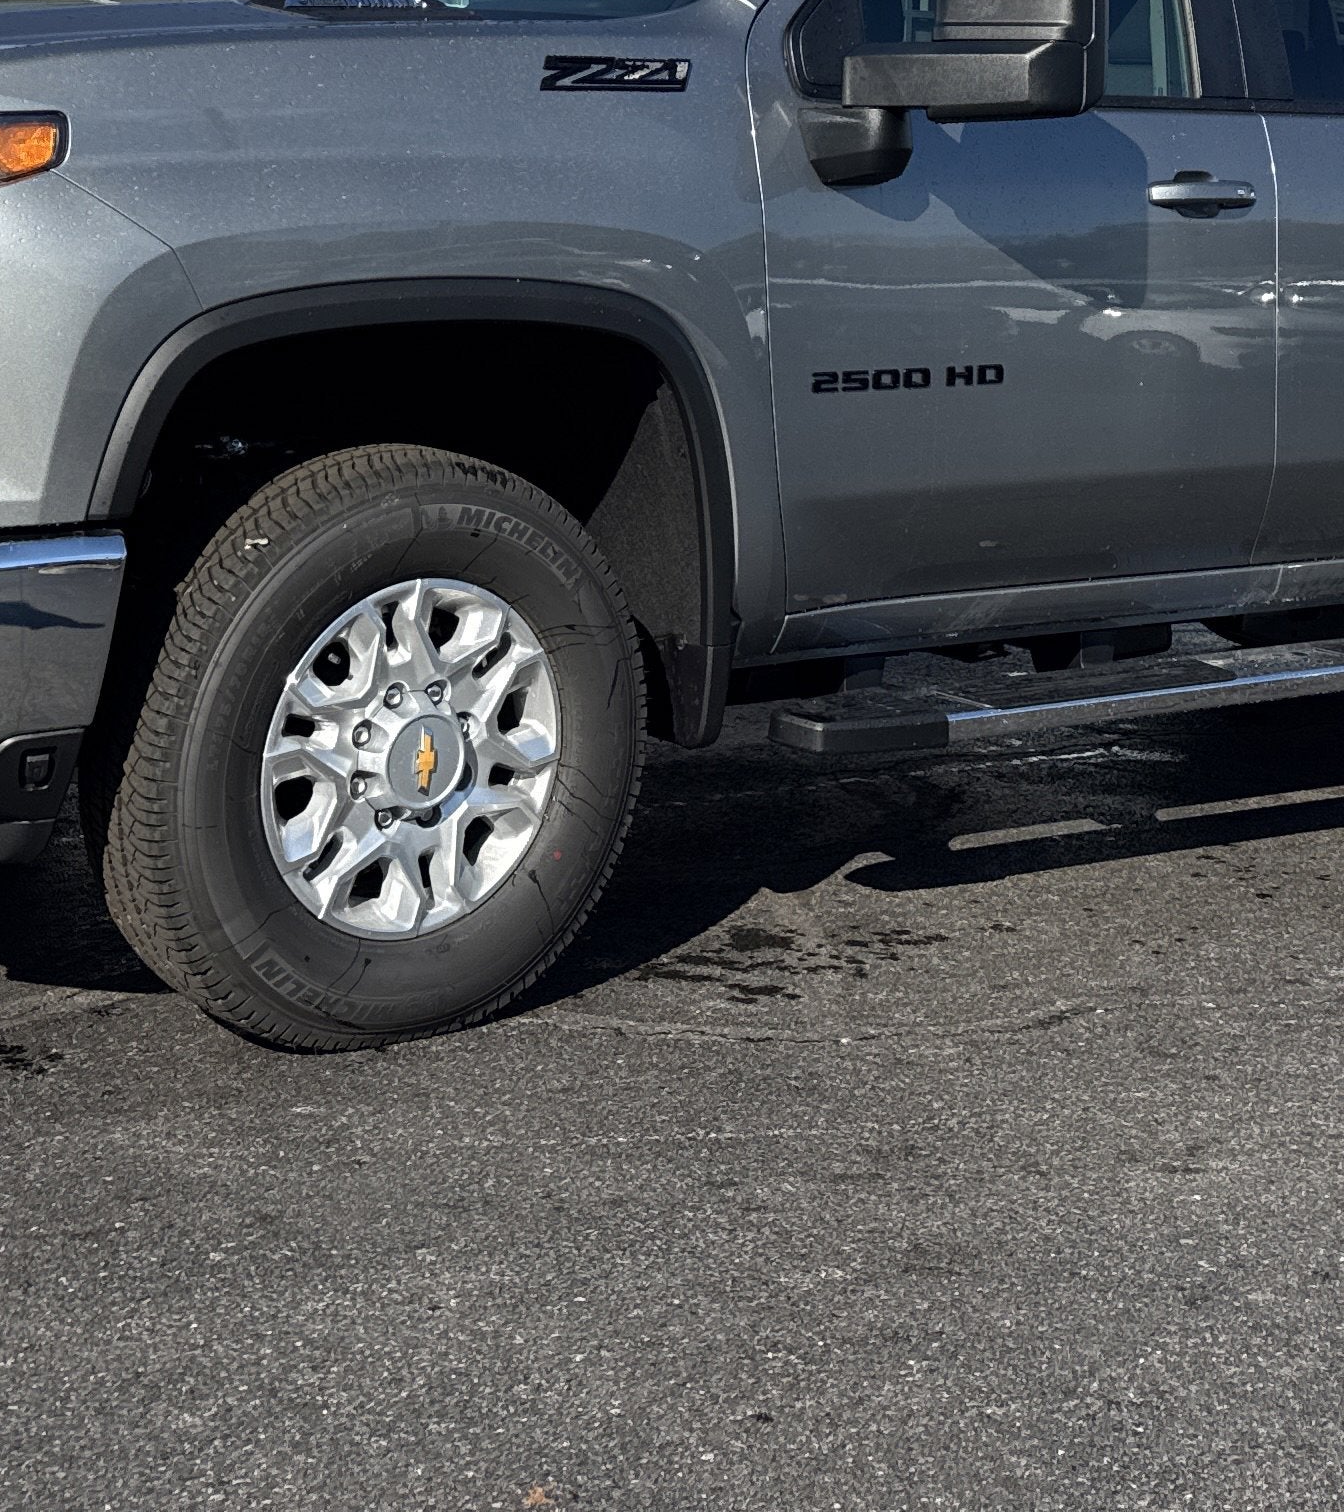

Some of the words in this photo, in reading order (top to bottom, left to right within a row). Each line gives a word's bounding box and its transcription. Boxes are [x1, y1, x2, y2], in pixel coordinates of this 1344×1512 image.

[540, 55, 693, 93] Z71
[811, 368, 931, 394] 2500
[946, 364, 1004, 388] HD
[457, 506, 582, 584] MICHELIN
